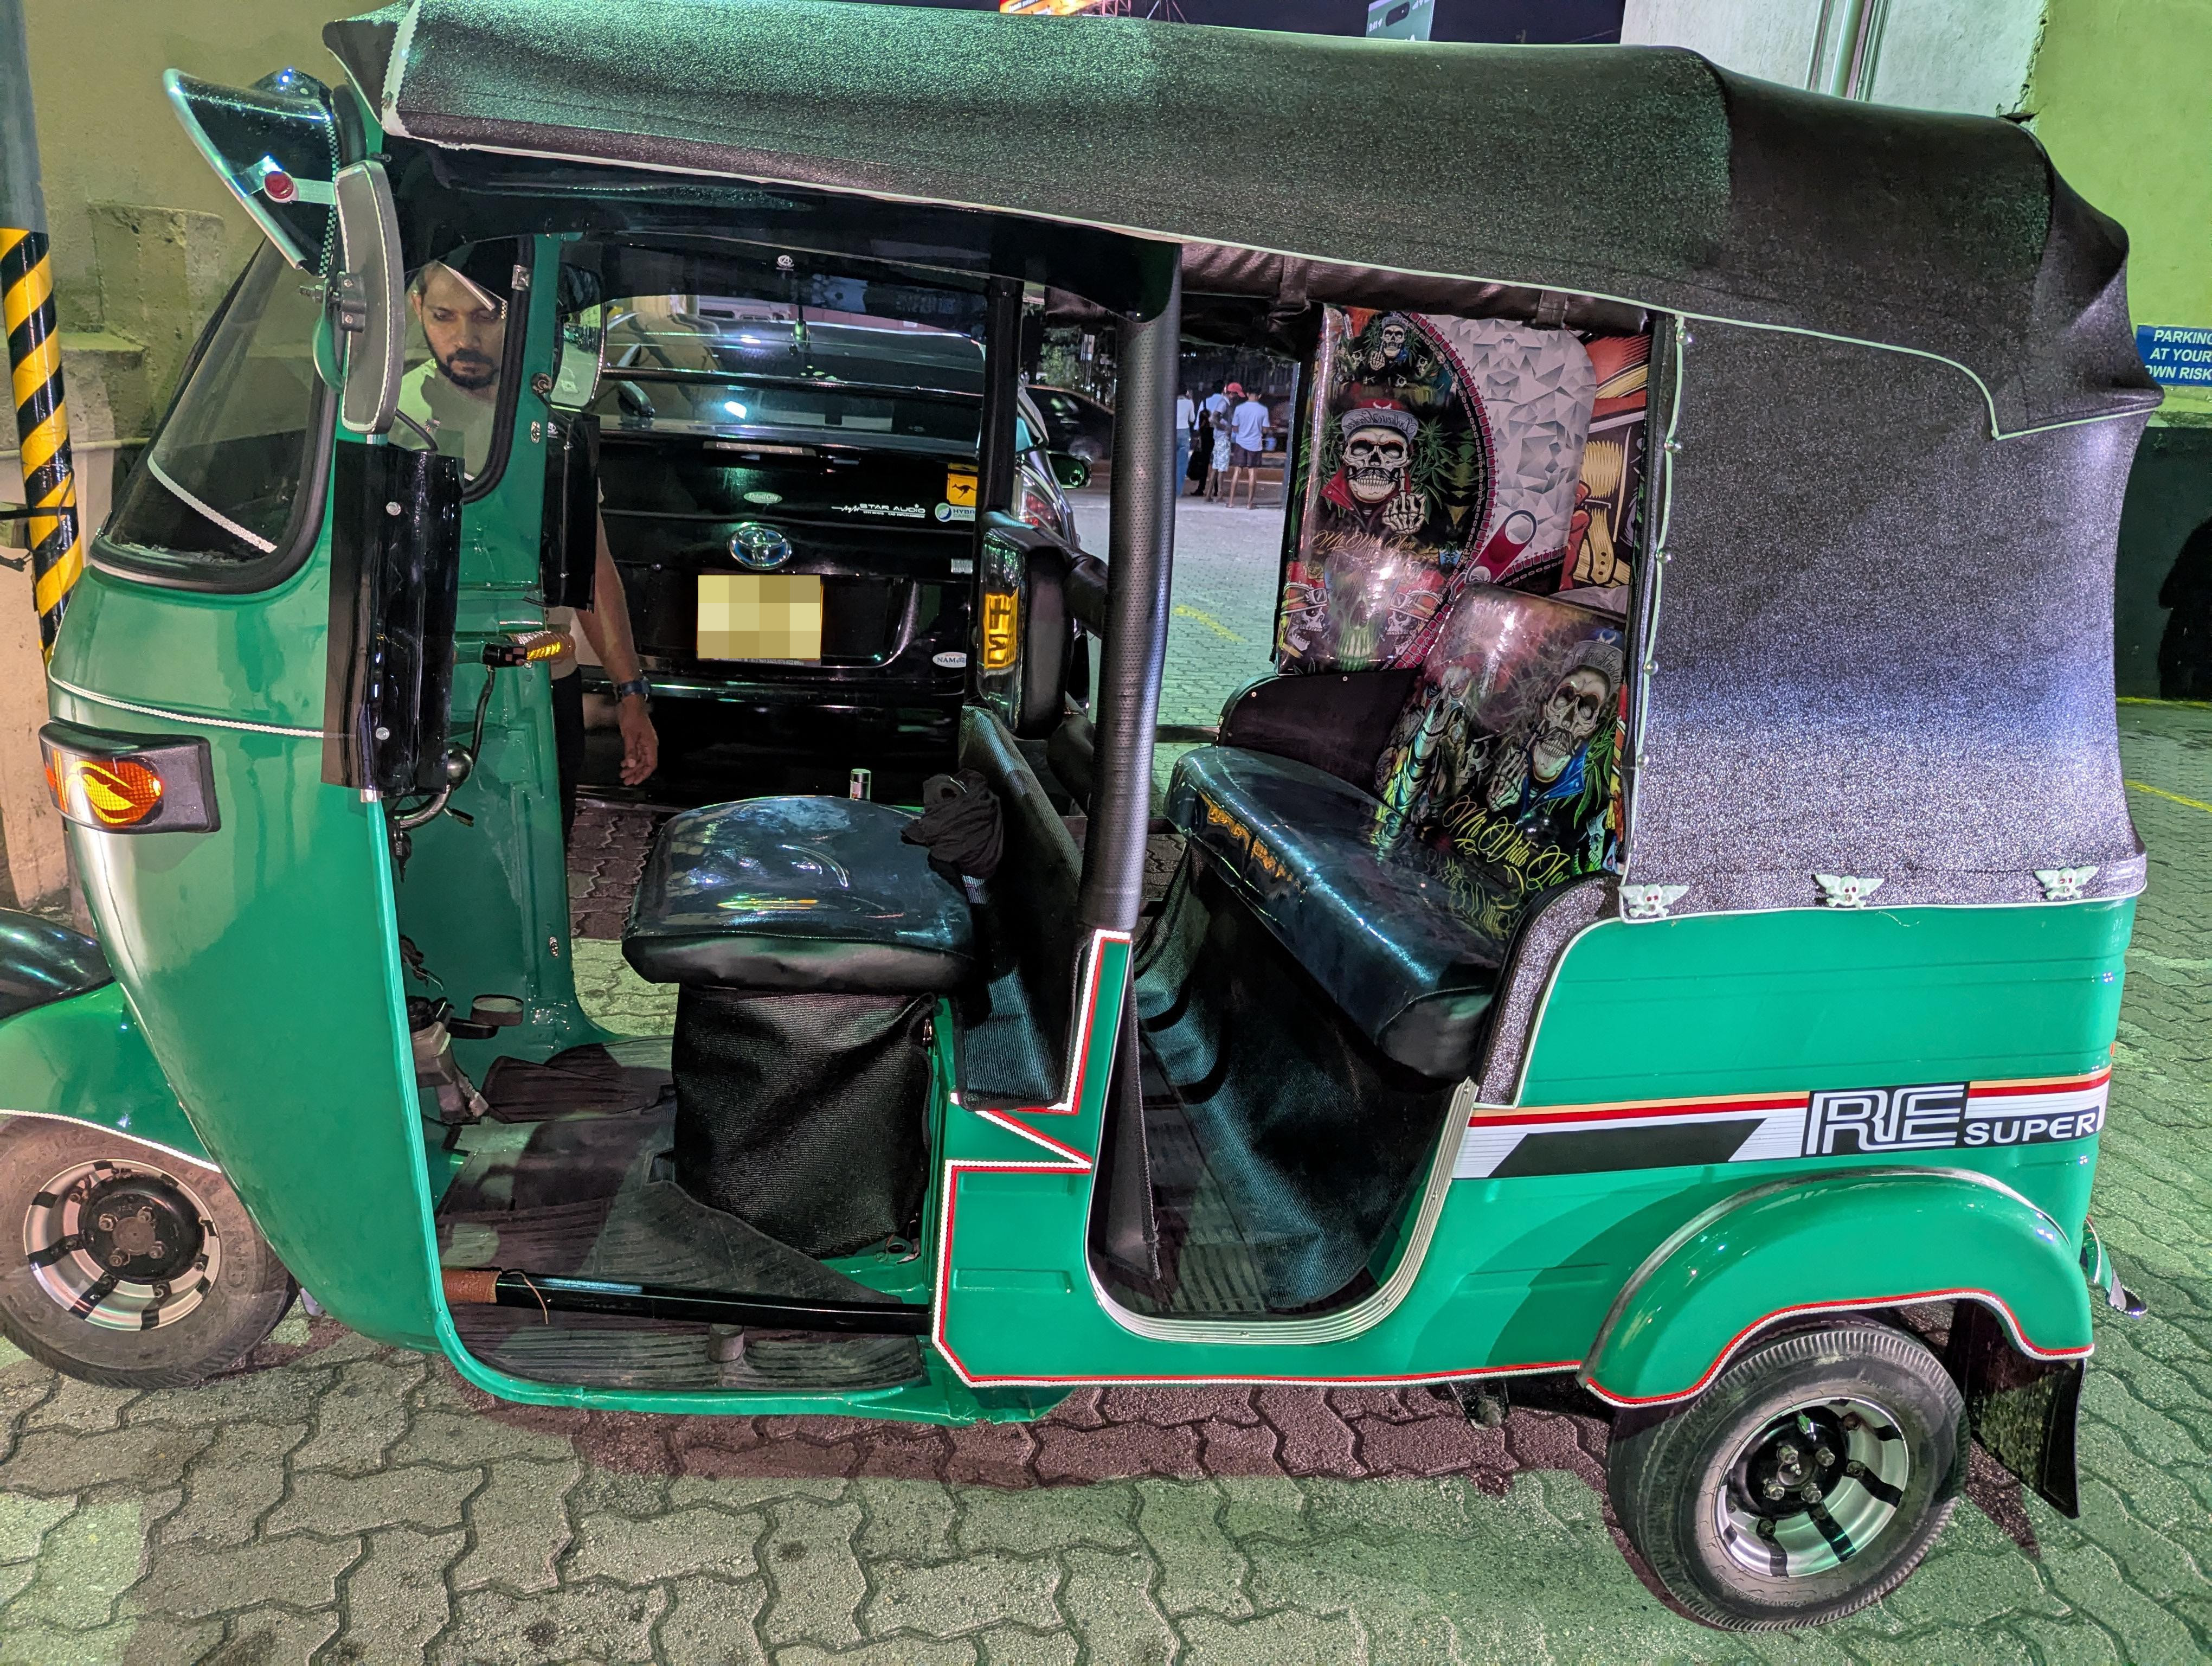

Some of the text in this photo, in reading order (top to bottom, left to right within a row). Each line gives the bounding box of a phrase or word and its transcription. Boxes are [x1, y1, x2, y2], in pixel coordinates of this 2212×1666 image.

[2149, 348, 2212, 362] AT YOUR
[2179, 367, 2212, 380] RISK
[1526, 845, 1570, 892] Loc
[1806, 1085, 2097, 1154] RE SUPER
